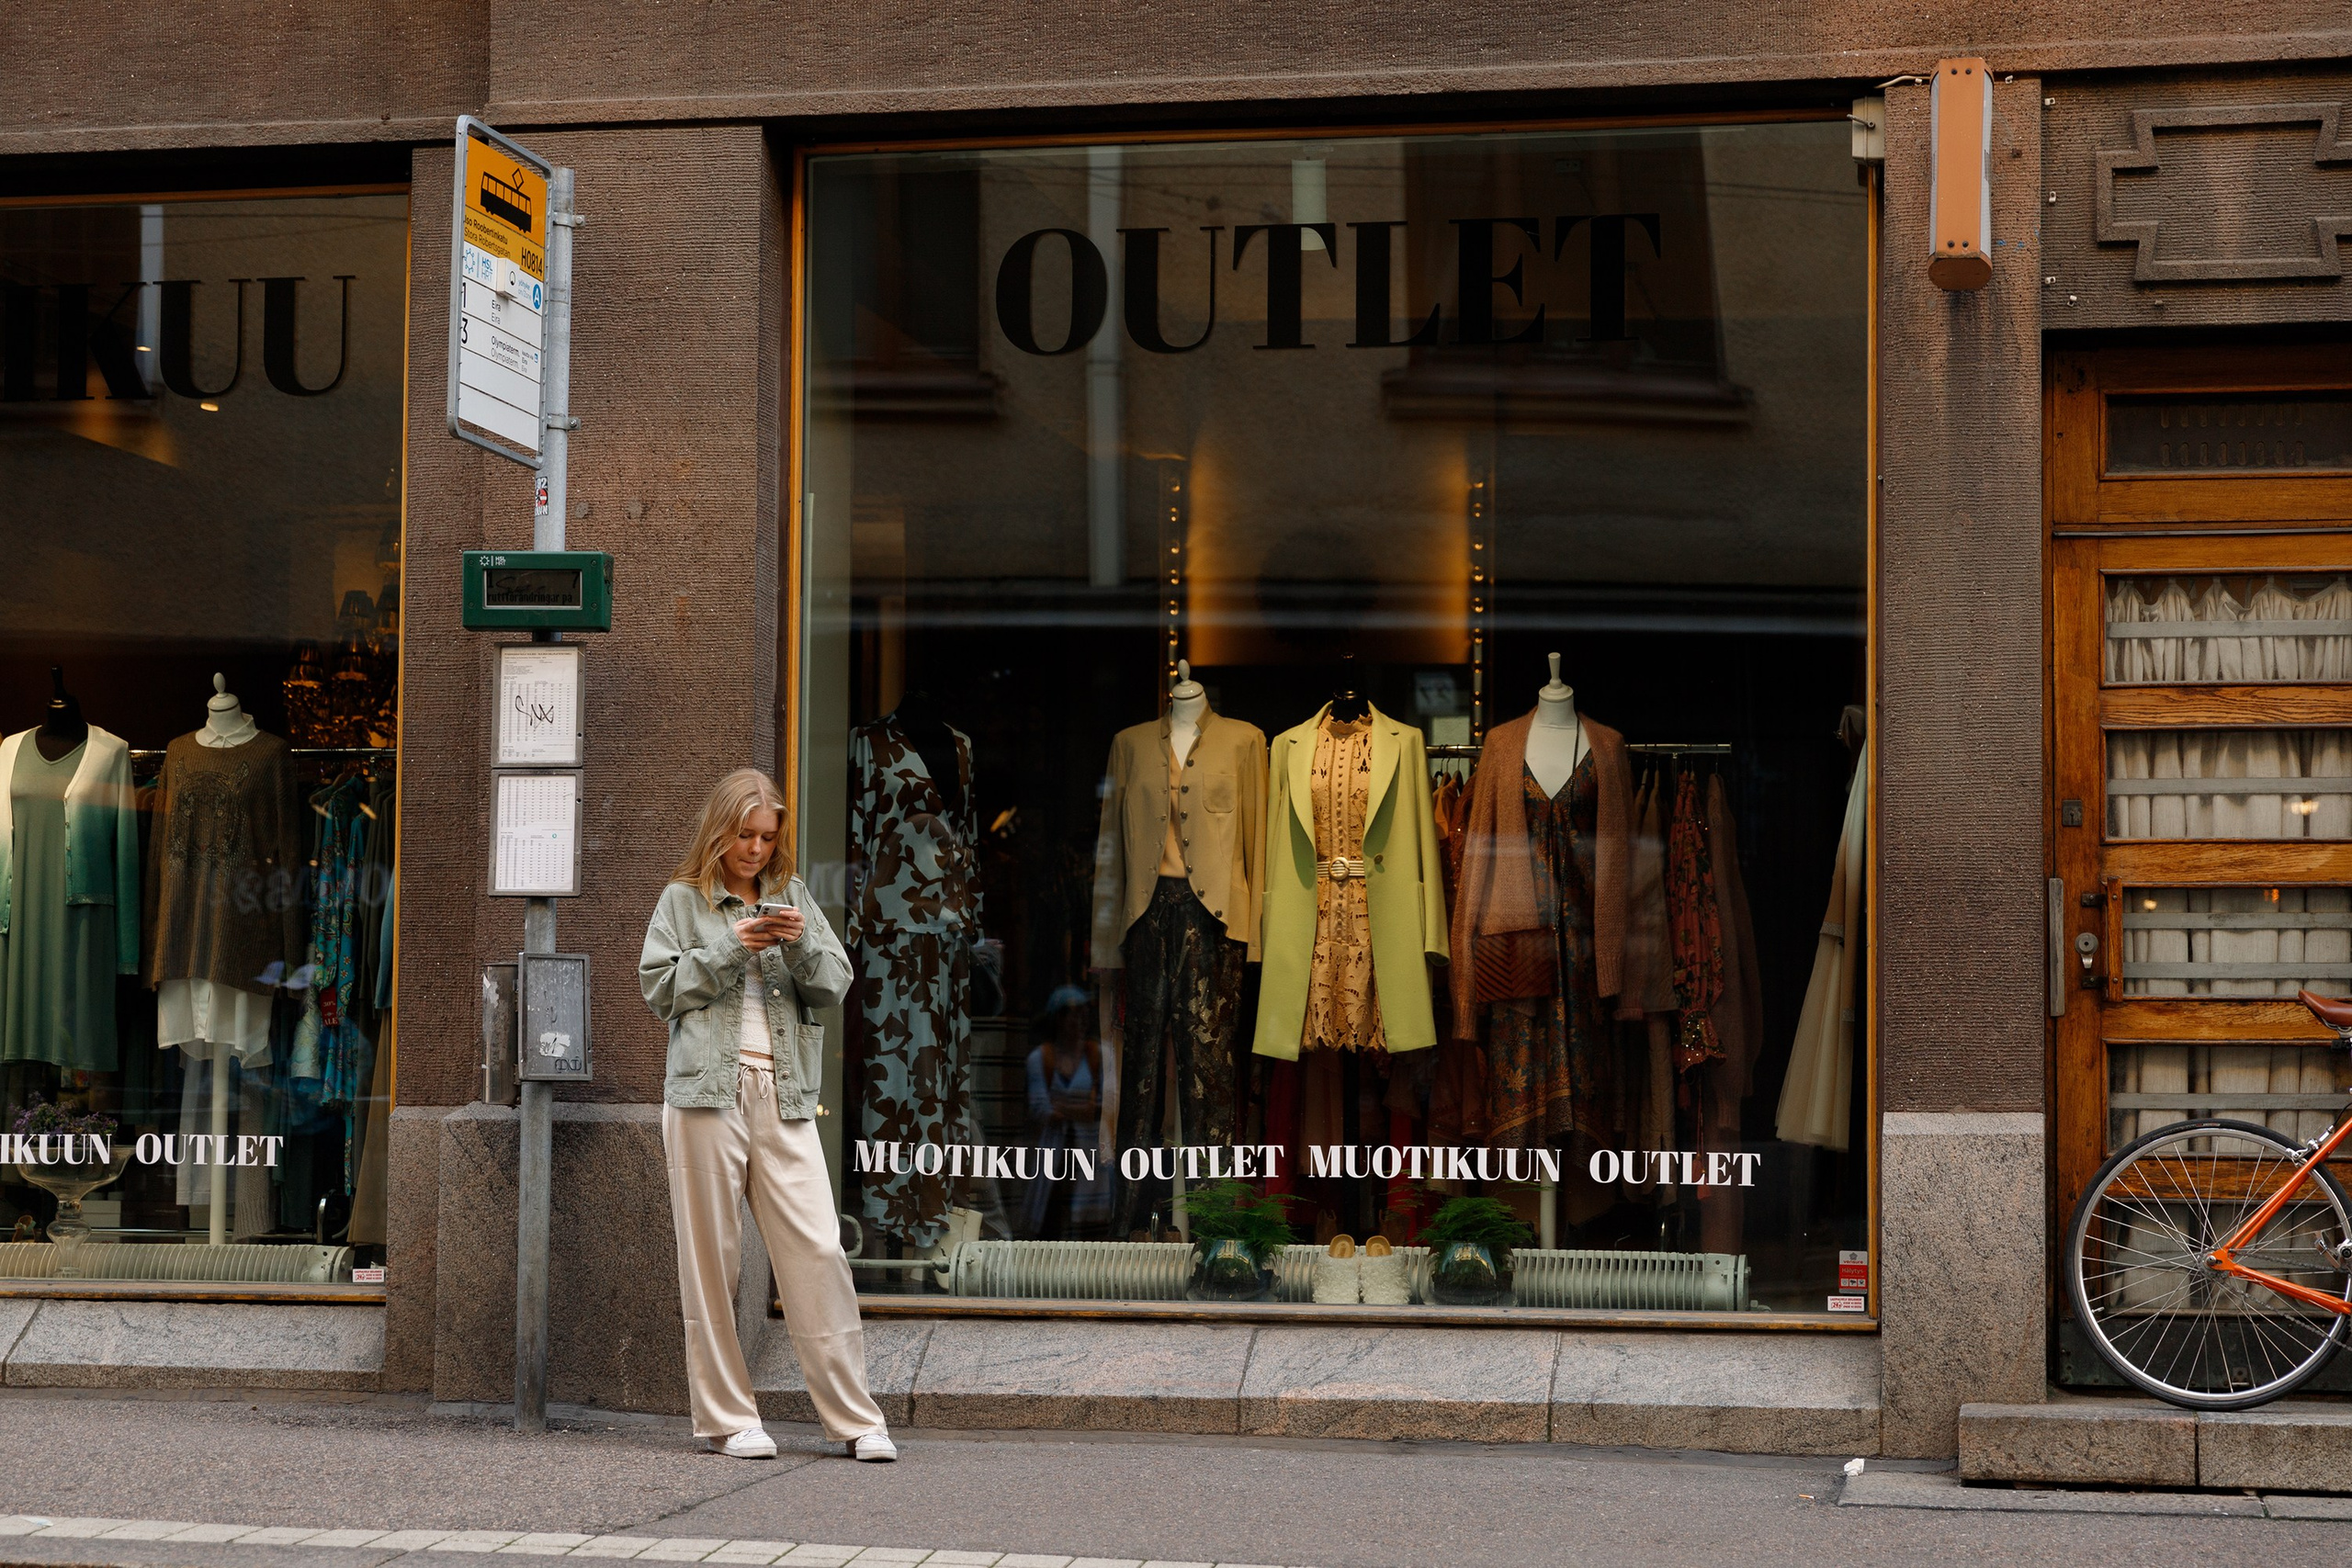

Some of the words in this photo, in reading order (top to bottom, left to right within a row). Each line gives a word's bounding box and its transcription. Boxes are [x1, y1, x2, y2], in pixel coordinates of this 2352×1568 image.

[464, 215, 473, 226] Iso
[473, 219, 508, 245] Roobertinkatu
[464, 227, 478, 242] Stora
[478, 234, 512, 259] Robertsgatan
[481, 257, 493, 271] HSL
[481, 267, 493, 282] HRT
[461, 282, 467, 308] 1
[995, 213, 1661, 356] OUTLET
[492, 299, 501, 312] Eira
[492, 312, 501, 324] Eira
[461, 317, 469, 344] 3
[0, 1134, 111, 1166] IKUUN
[135, 1134, 284, 1168] OUTLET
[853, 1139, 1097, 1181] MUOTIKUUN
[1120, 1144, 1284, 1181] OUTLET
[1307, 1145, 1562, 1182] MUOTIKUUN
[1589, 1149, 1761, 1187] OUTLET
